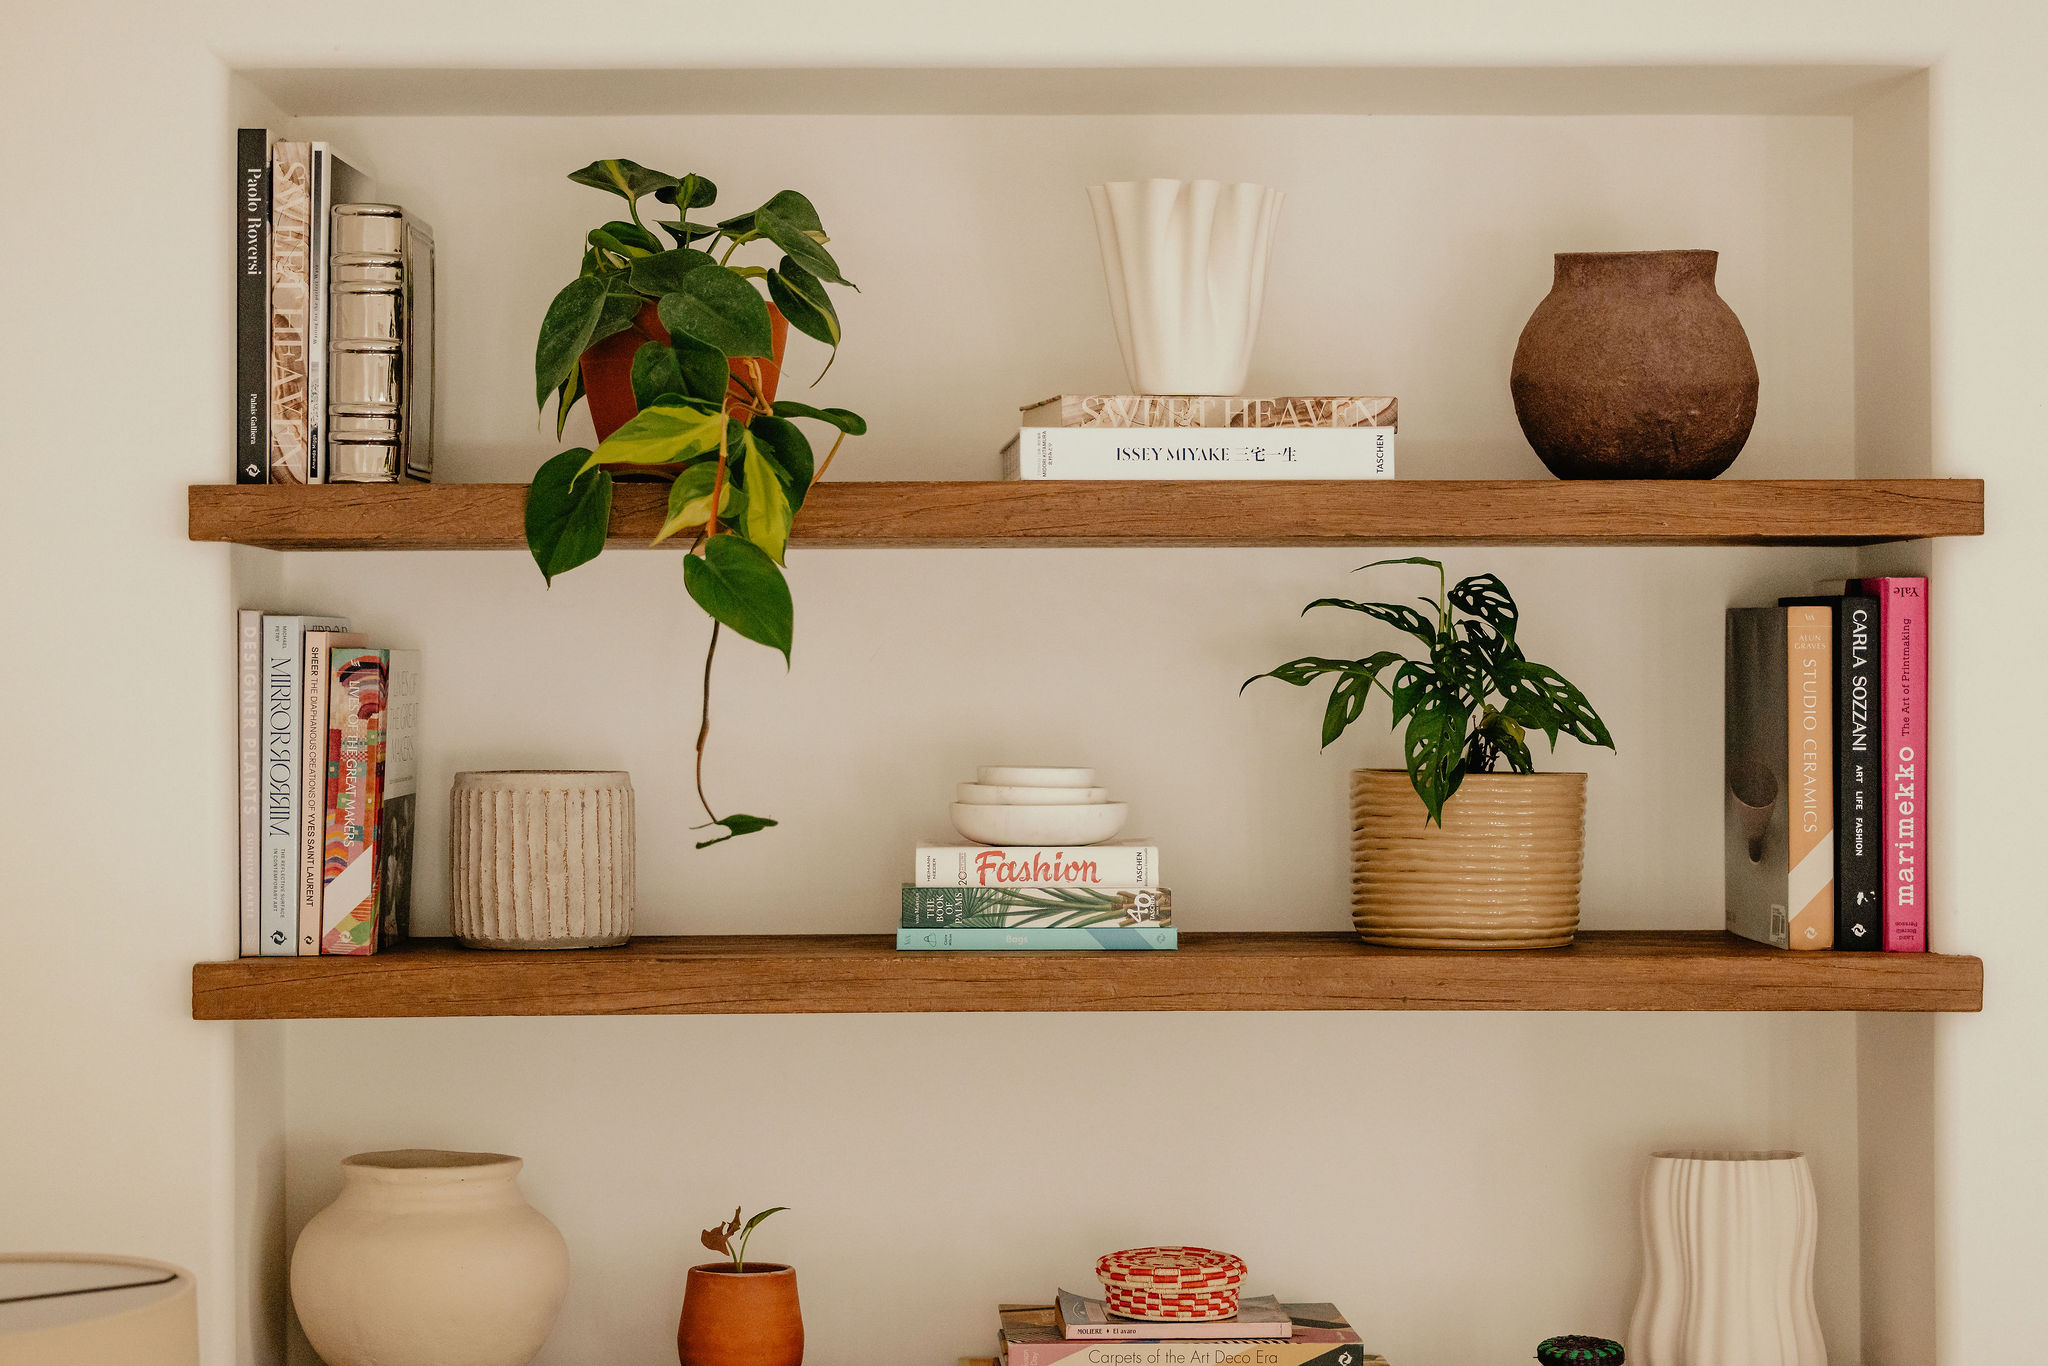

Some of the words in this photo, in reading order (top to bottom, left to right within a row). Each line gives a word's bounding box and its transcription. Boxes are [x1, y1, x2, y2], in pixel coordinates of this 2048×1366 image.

[247, 168, 262, 212] Paolo
[272, 161, 305, 299] SWEET
[247, 217, 262, 276] Roversi
[250, 393, 258, 415] Palais
[271, 307, 304, 469] HEAVEN
[1080, 399, 1217, 427] SWEET
[1225, 399, 1380, 427] HEAVEN
[250, 416, 258, 445] Galliera
[1116, 446, 1163, 461] ISSEY
[1166, 446, 1230, 461] MIYAKE
[1376, 434, 1384, 474] TASCHEN
[1893, 586, 1920, 598] Yale
[1852, 609, 1868, 668] CARLA
[1901, 618, 1912, 681] Printmaking
[311, 646, 319, 676] SHEER
[243, 626, 257, 730] DESIGNER
[310, 678, 318, 693] THE
[1802, 658, 1817, 730] STUDIO
[1901, 684, 1911, 695] of
[269, 657, 292, 746] MIRROR
[347, 680, 360, 713] LIVES
[1901, 697, 1911, 714] Art
[309, 696, 318, 750] DIAPHANOUS
[347, 714, 360, 731] OF
[1852, 675, 1868, 751] SOZZANI
[1901, 717, 1911, 737] The
[347, 734, 359, 757] THE
[243, 738, 257, 815] PLANTS
[308, 751, 317, 799] CREATIONS
[345, 759, 358, 796] GREAT
[1802, 738, 1817, 833] CERAMICS
[1855, 765, 1863, 783] ART
[308, 800, 316, 812] OF
[1855, 791, 1863, 810] LIFE
[307, 813, 315, 839] YVES
[343, 801, 357, 847] MAKERS
[1855, 817, 1863, 856] FASHION
[1894, 746, 1915, 906] marimekko
[306, 839, 315, 864] SAINT
[975, 850, 1103, 886] Fashion
[306, 866, 314, 908] LAURENT
[926, 898, 935, 919] THE
[935, 894, 944, 922] BOOK
[945, 901, 953, 915] OF
[954, 892, 963, 924] PALMS
[1126, 893, 1152, 922] 40
[1088, 1349, 1142, 1366] Carpets
[1147, 1348, 1161, 1363] of
[1165, 1348, 1186, 1363] the
[1190, 1350, 1210, 1364] Art
[1215, 1349, 1251, 1364] Deco
[1256, 1349, 1278, 1364] Era
